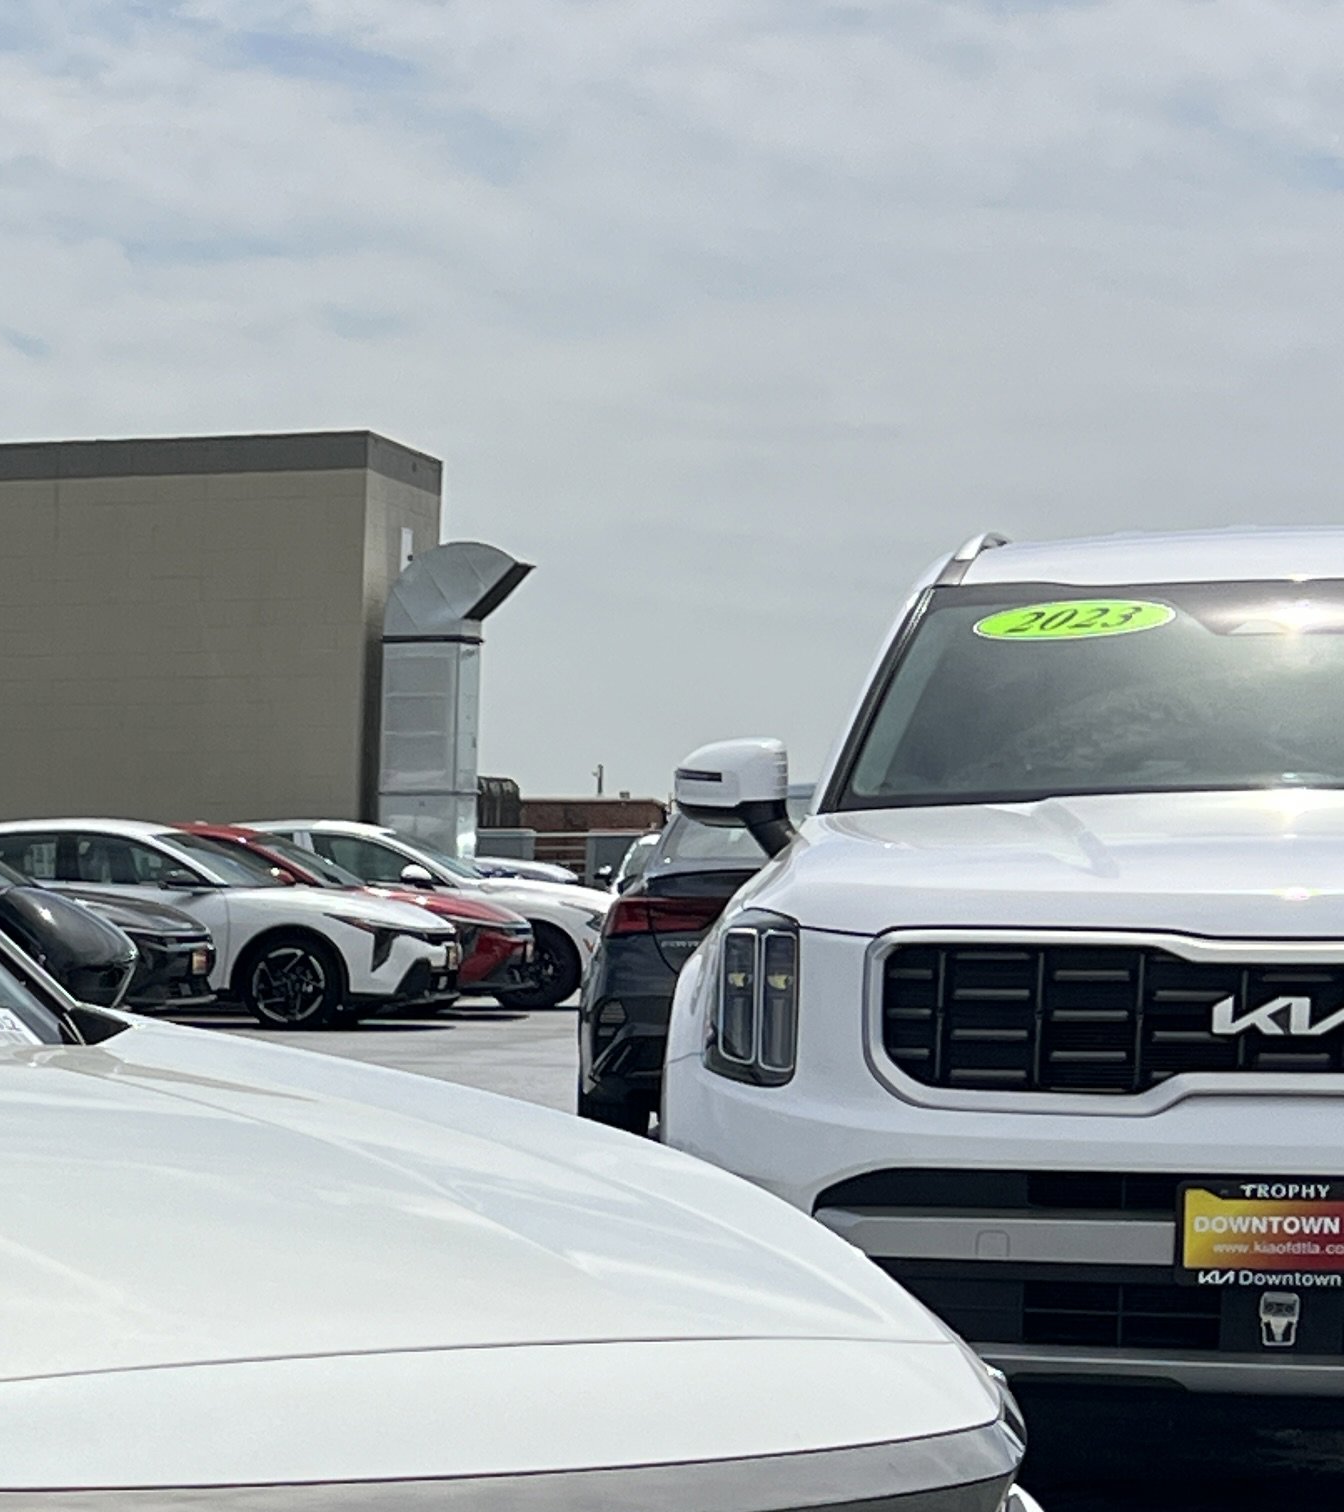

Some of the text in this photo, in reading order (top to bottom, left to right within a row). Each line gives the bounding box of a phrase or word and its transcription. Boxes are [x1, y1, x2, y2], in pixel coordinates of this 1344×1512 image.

[1003, 606, 1143, 634] 2023
[1239, 1184, 1331, 1199] TROPHY
[1193, 1215, 1340, 1235] DOWNTOWN
[1238, 1270, 1342, 1287] Downtown
